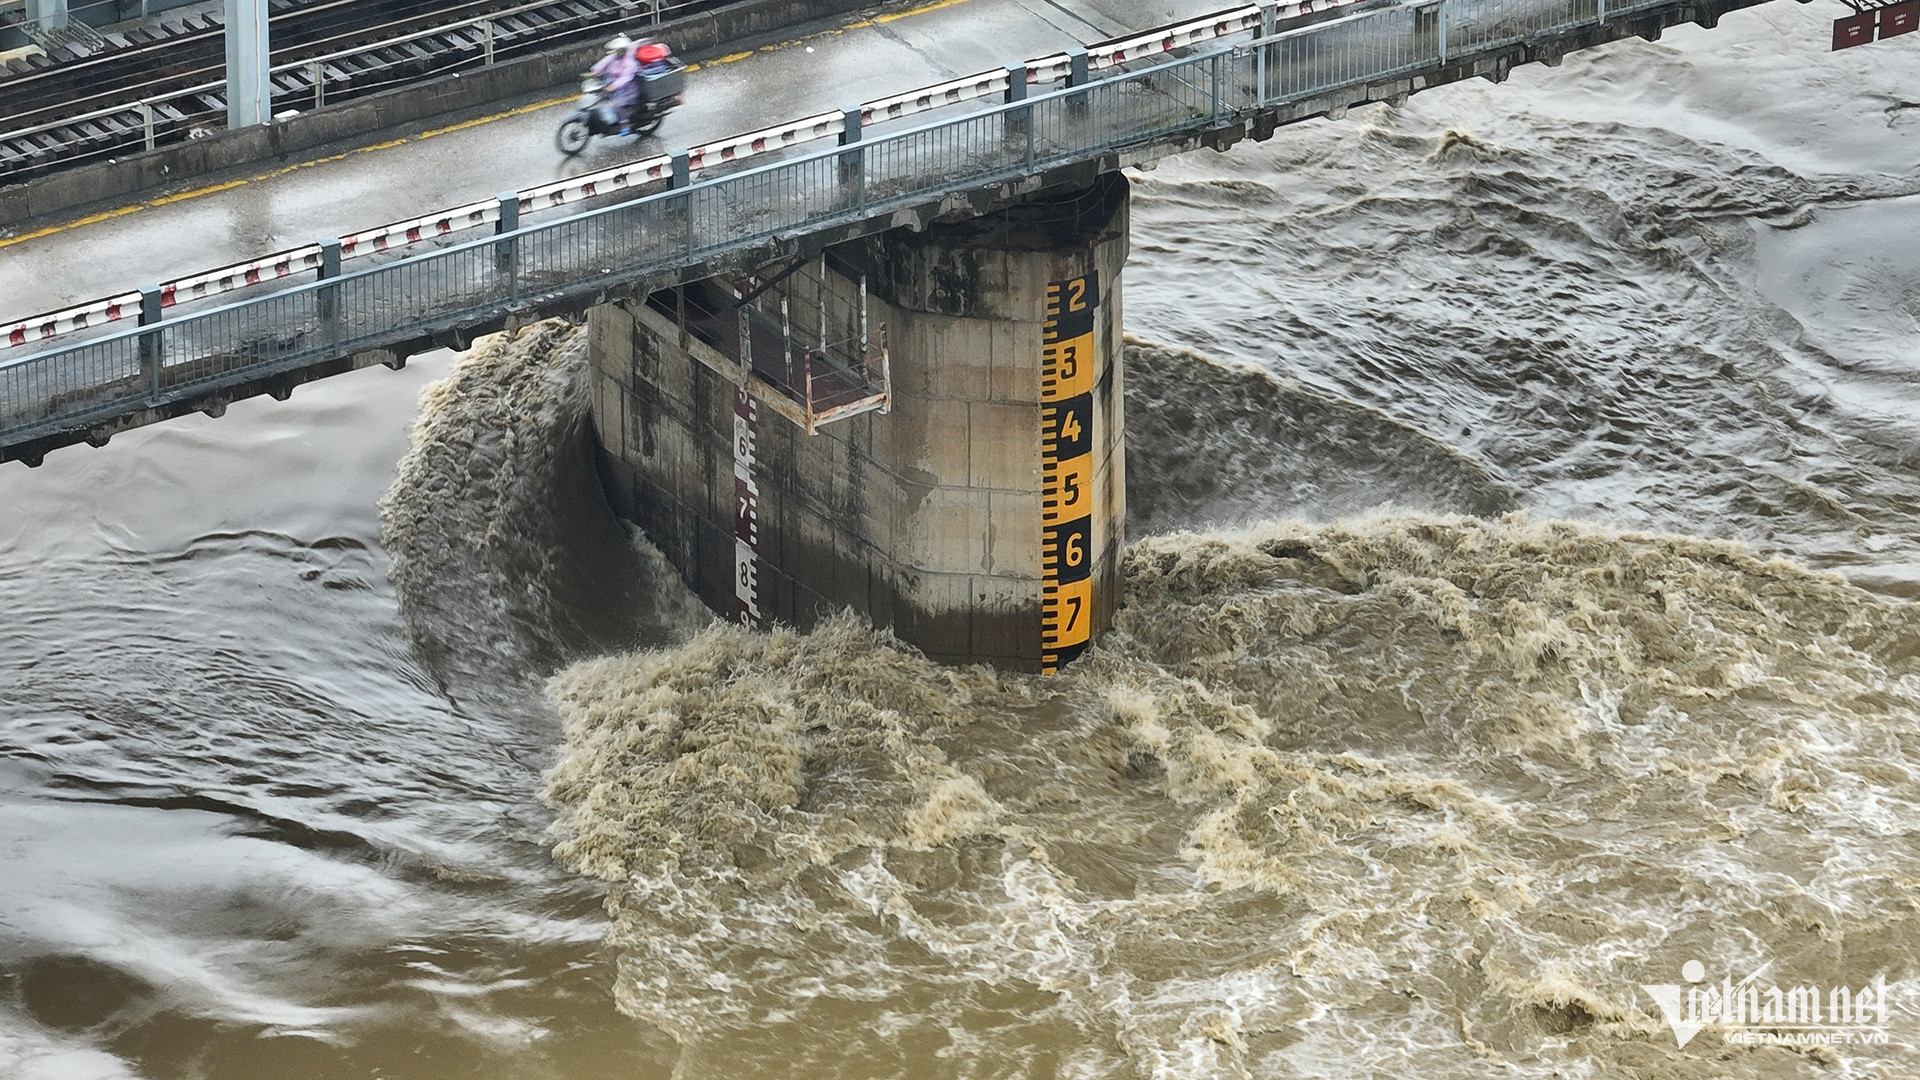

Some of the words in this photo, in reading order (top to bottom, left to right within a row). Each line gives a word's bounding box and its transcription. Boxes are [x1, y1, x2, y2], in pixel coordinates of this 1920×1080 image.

[1067, 278, 1087, 313] 2
[1060, 346, 1077, 380] 3
[1060, 410, 1082, 443] 4
[738, 436, 747, 457] 6
[1063, 472, 1079, 506] 5
[739, 496, 748, 519] 7
[1065, 532, 1083, 567] 6
[739, 561, 749, 588] 8
[1065, 596, 1082, 632] 7
